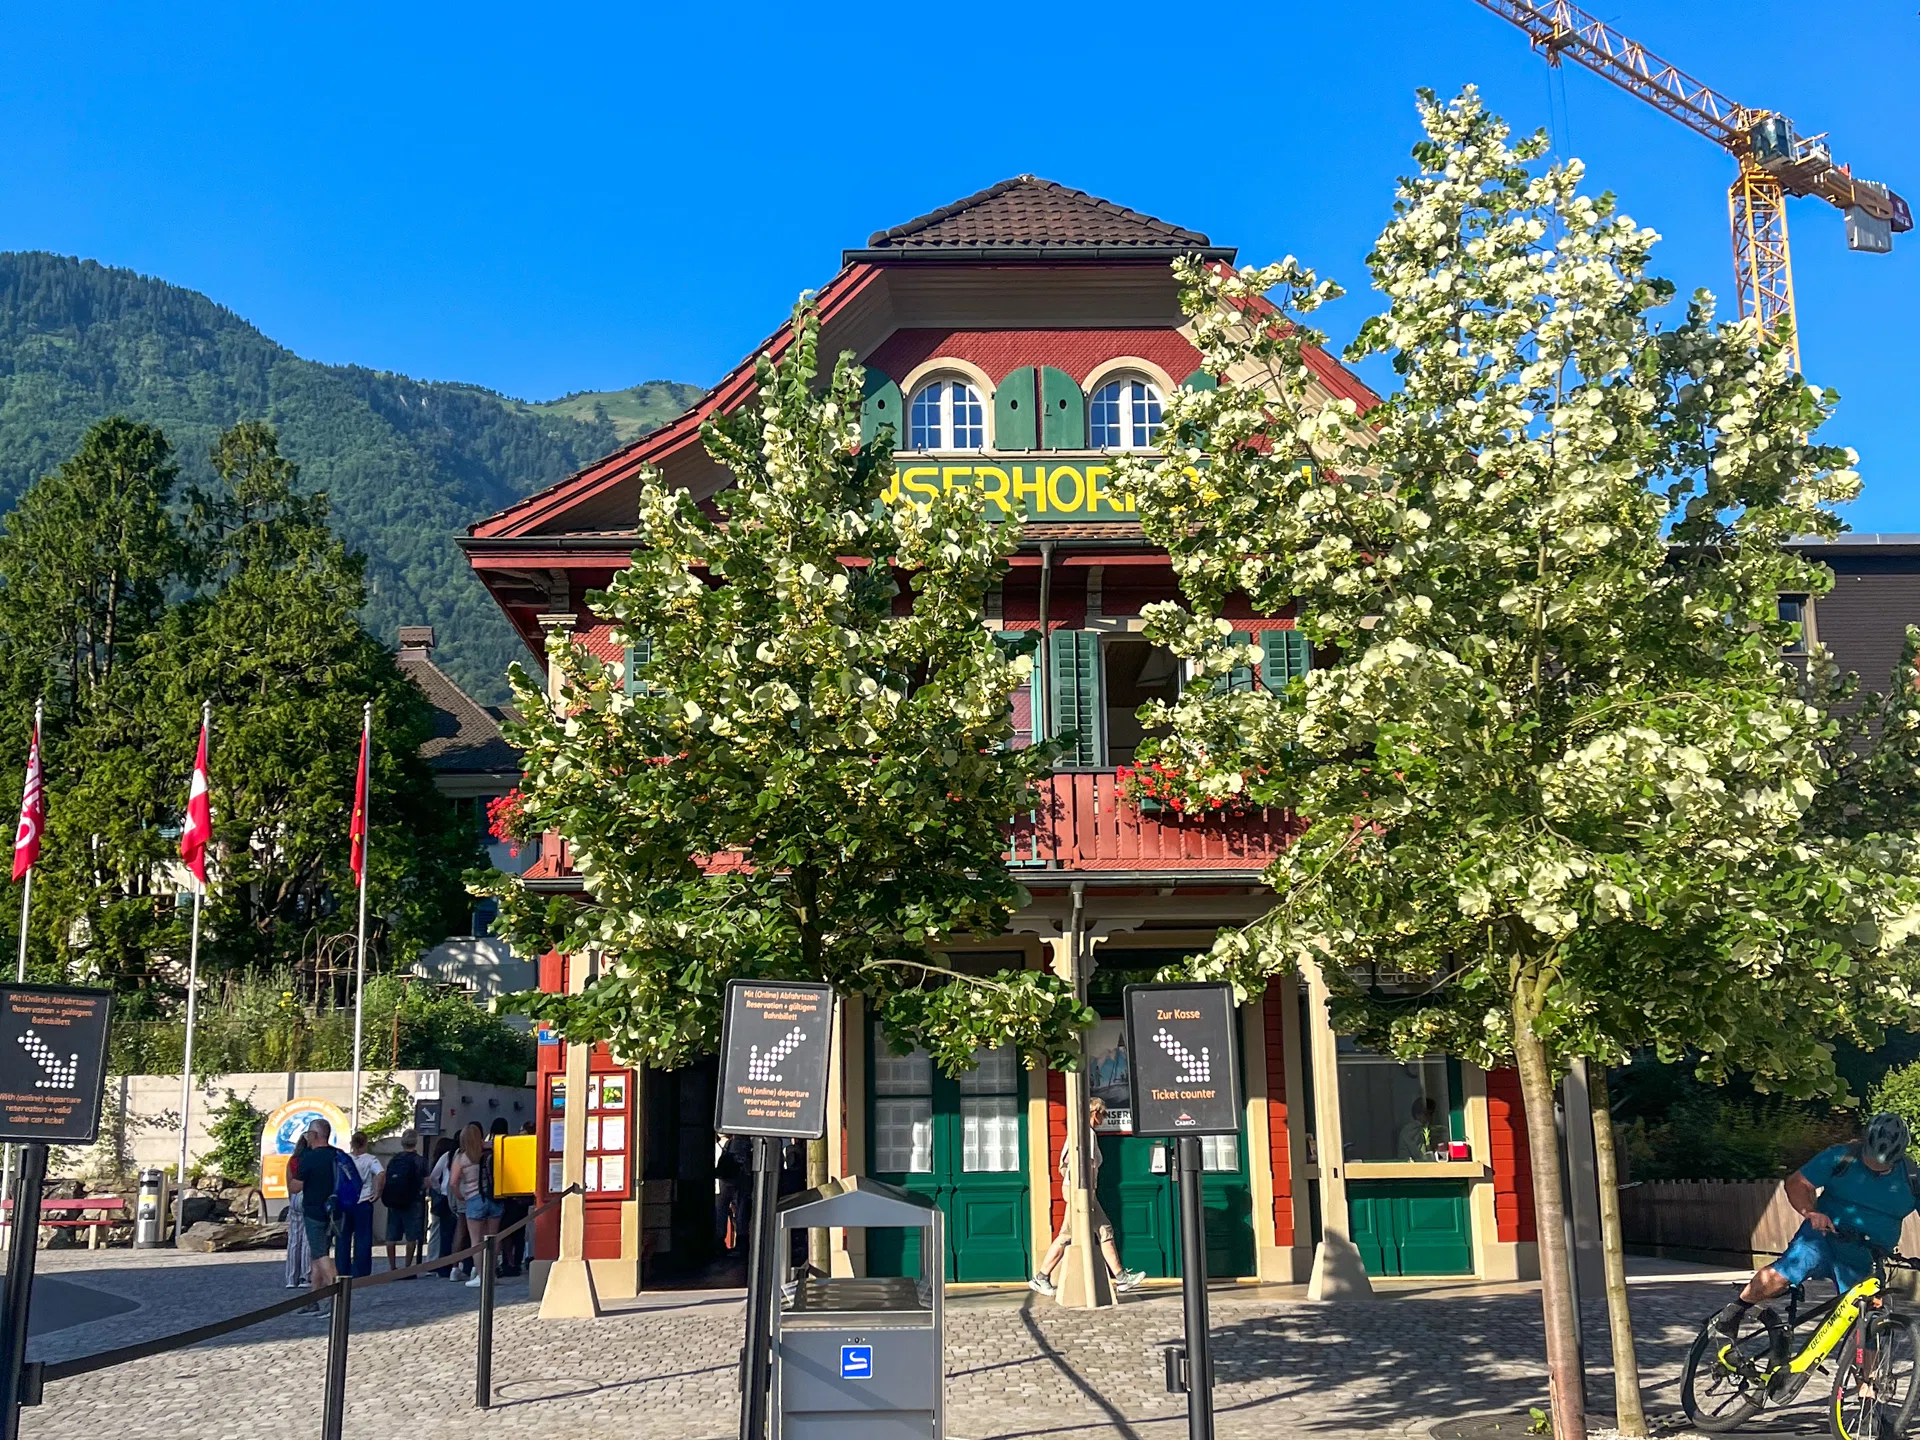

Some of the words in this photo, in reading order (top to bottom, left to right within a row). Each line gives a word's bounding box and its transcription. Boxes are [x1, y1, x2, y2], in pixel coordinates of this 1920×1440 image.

[744, 990, 754, 998] Mit
[755, 990, 779, 1000] (Online)
[780, 992, 820, 1001] Abfahrtszeit-
[746, 1000, 783, 1009] Reservation
[789, 1003, 817, 1012] gültigem
[764, 1011, 797, 1020] Bahnbillett
[1156, 1009, 1173, 1020] Zur
[1174, 1009, 1200, 1019] Kasse
[737, 1086, 752, 1095] With
[753, 1087, 776, 1097] (online)
[777, 1088, 809, 1098] departure
[1151, 1089, 1179, 1100] Ticket
[1180, 1089, 1216, 1099] counter
[744, 1098, 779, 1106] reservation
[786, 1100, 801, 1108] valid
[747, 1108, 765, 1116] cable
[778, 1109, 796, 1118] ticket
